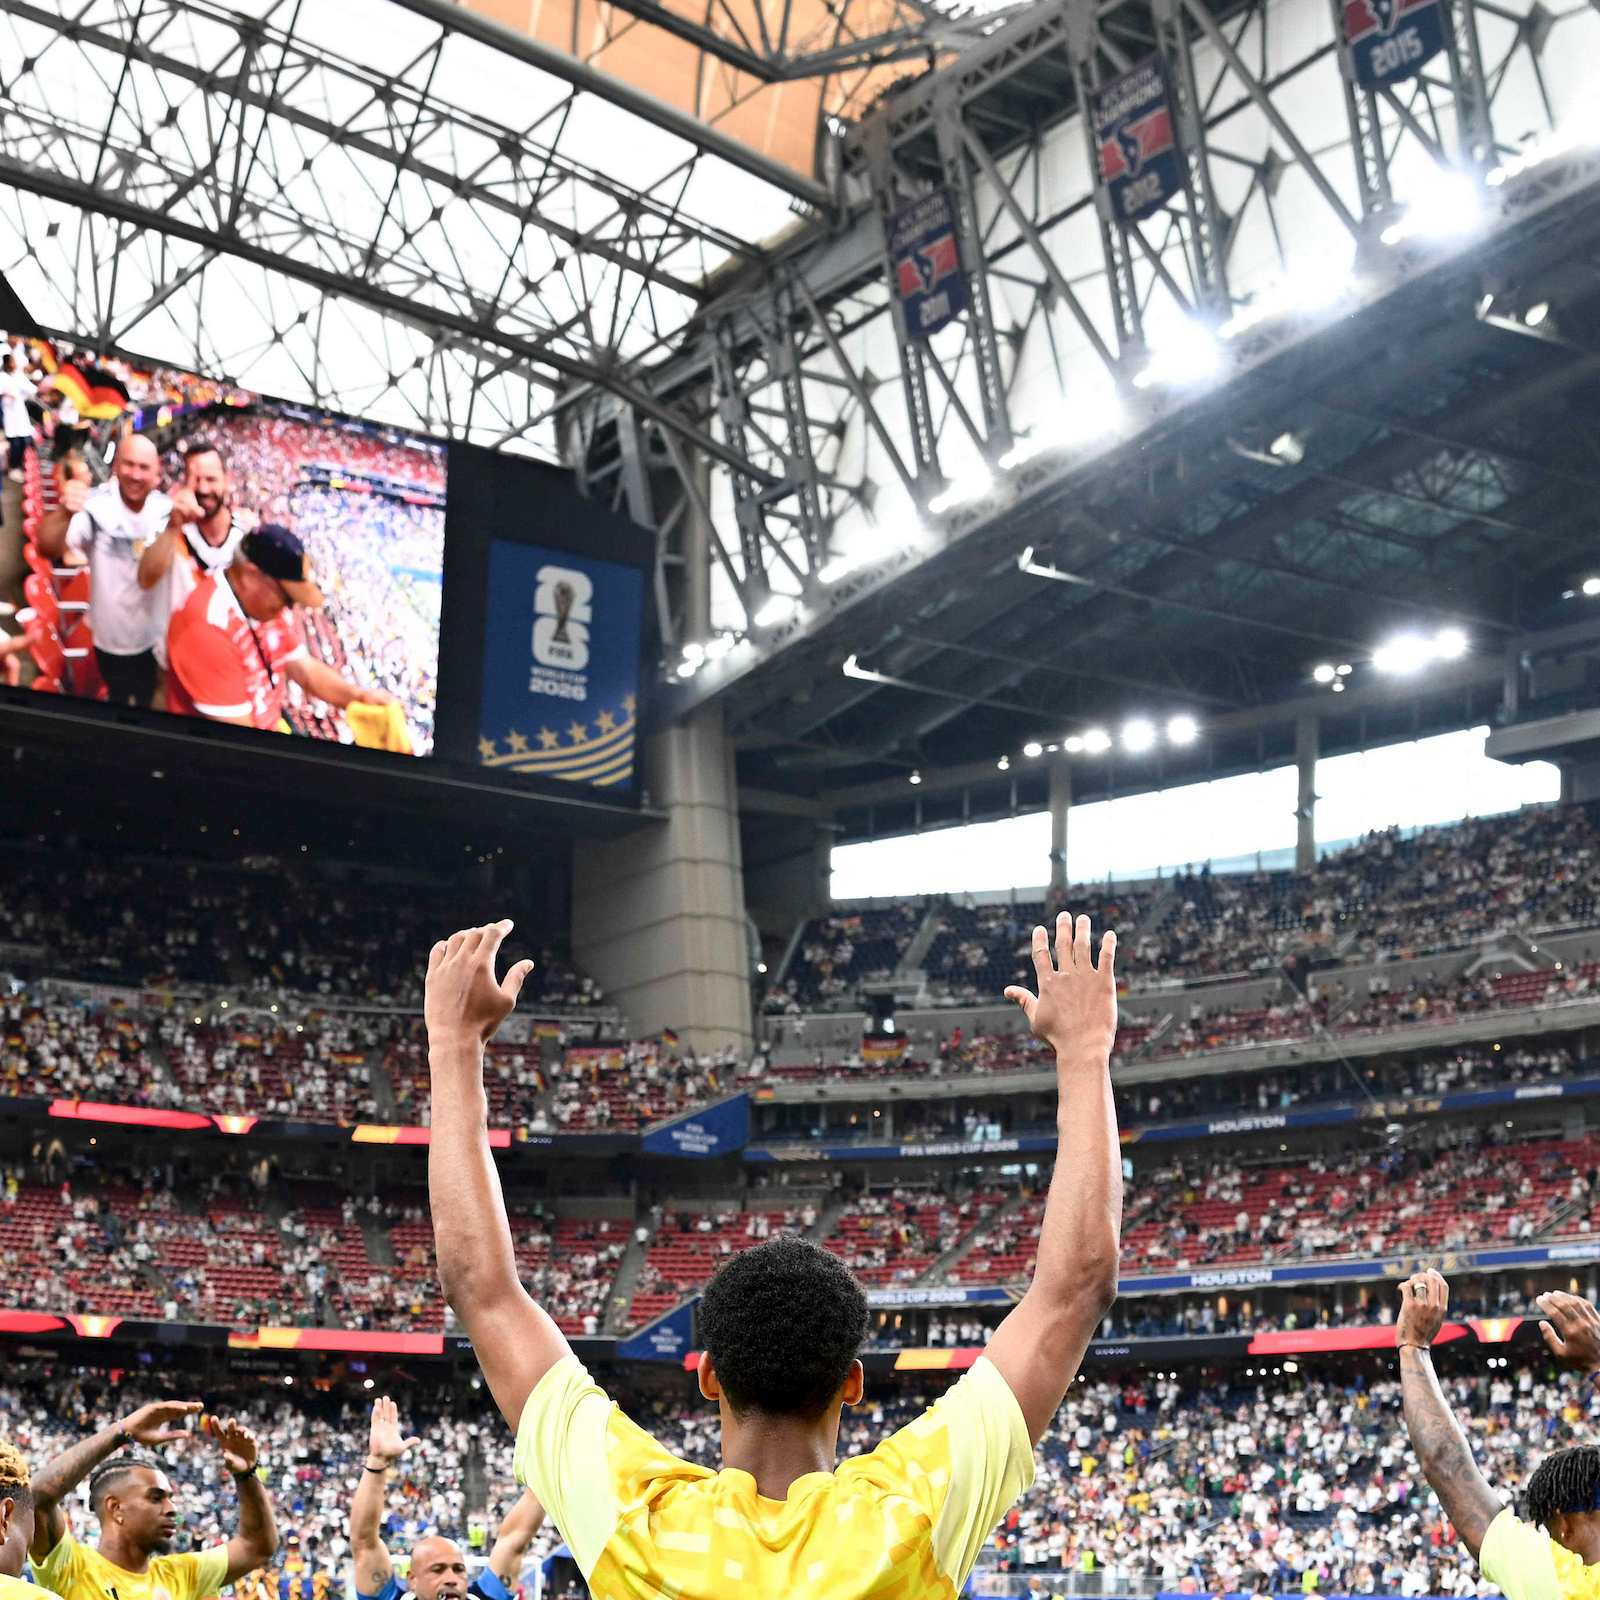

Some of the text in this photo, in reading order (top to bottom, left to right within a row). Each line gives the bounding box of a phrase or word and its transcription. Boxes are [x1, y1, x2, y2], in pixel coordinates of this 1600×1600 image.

[528, 677, 588, 701] 2026
[1208, 1115, 1287, 1134] HOUSTON
[925, 1142, 960, 1156] WORLD
[962, 1141, 982, 1154] CUP
[1191, 1271, 1273, 1287] HOUSTON
